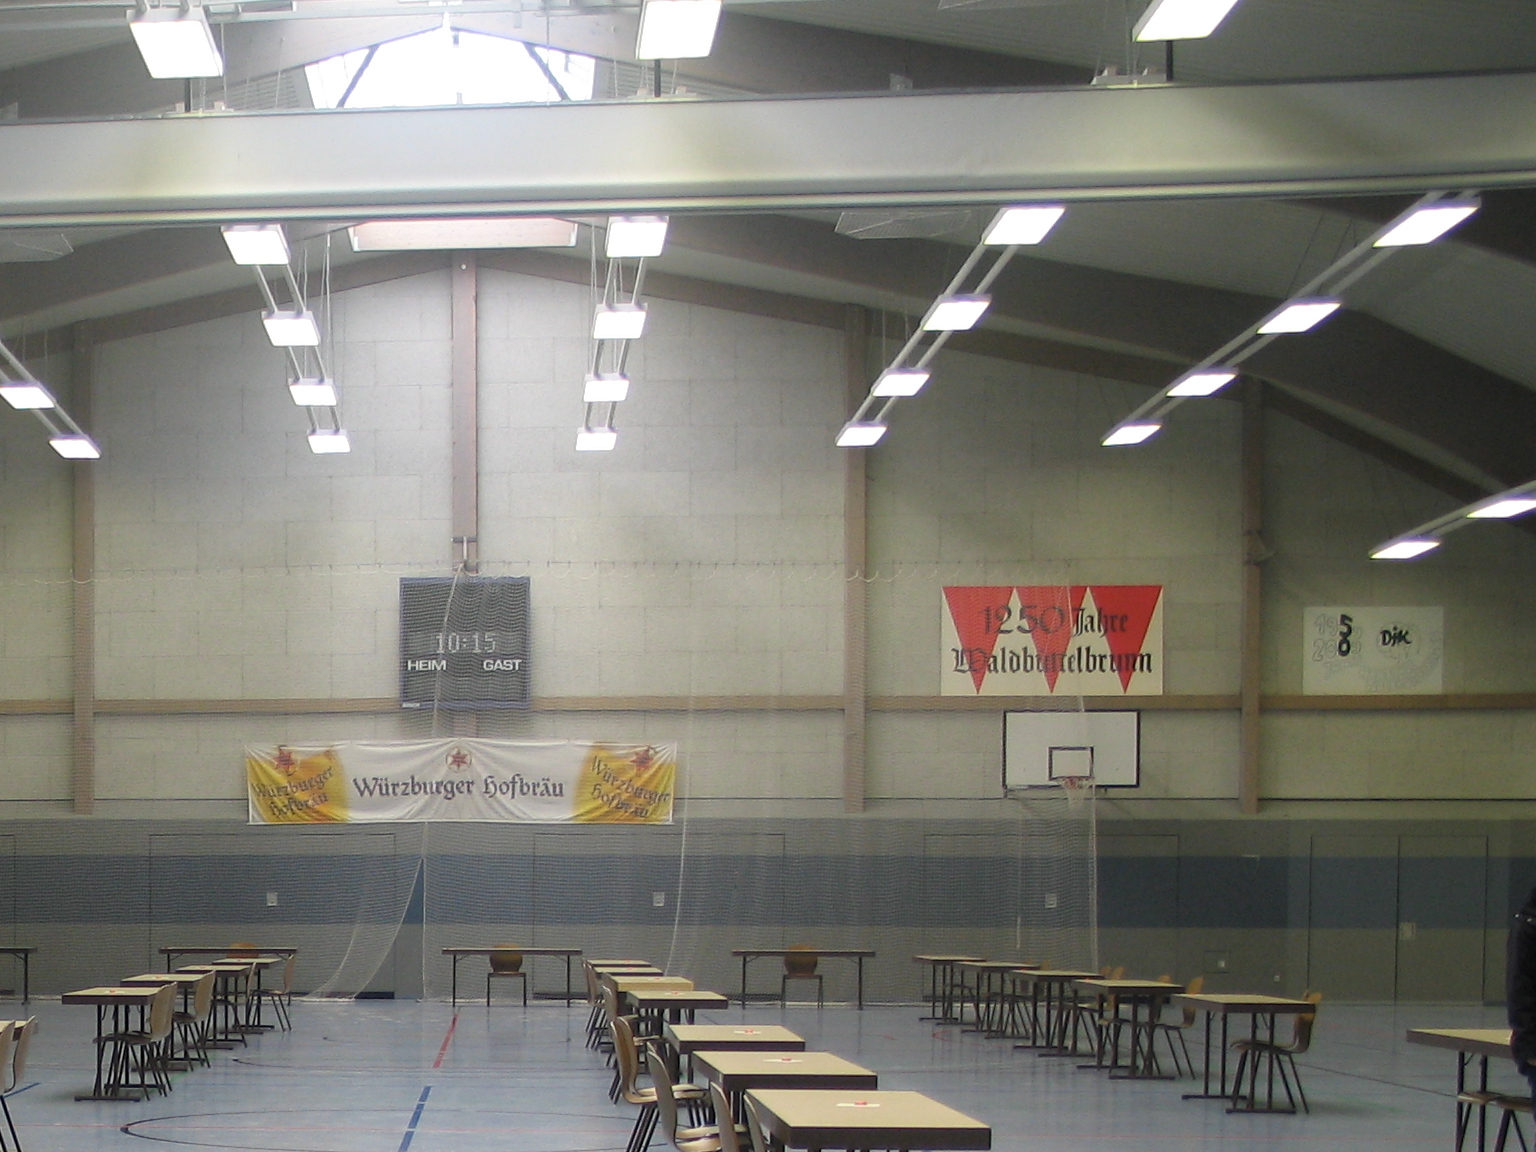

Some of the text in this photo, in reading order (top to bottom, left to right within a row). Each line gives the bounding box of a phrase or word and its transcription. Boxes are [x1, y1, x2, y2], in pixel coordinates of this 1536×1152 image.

[983, 605, 1129, 638] 1250 Jahre
[435, 632, 497, 654] 10:15
[407, 659, 523, 672] HEIM GAST
[252, 766, 334, 798] Würzburger
[352, 774, 565, 801] Würzburger Hofbräu
[591, 755, 670, 807] Würzburger
[269, 792, 329, 819] Hofbräu
[590, 783, 650, 819] Hofbräu
